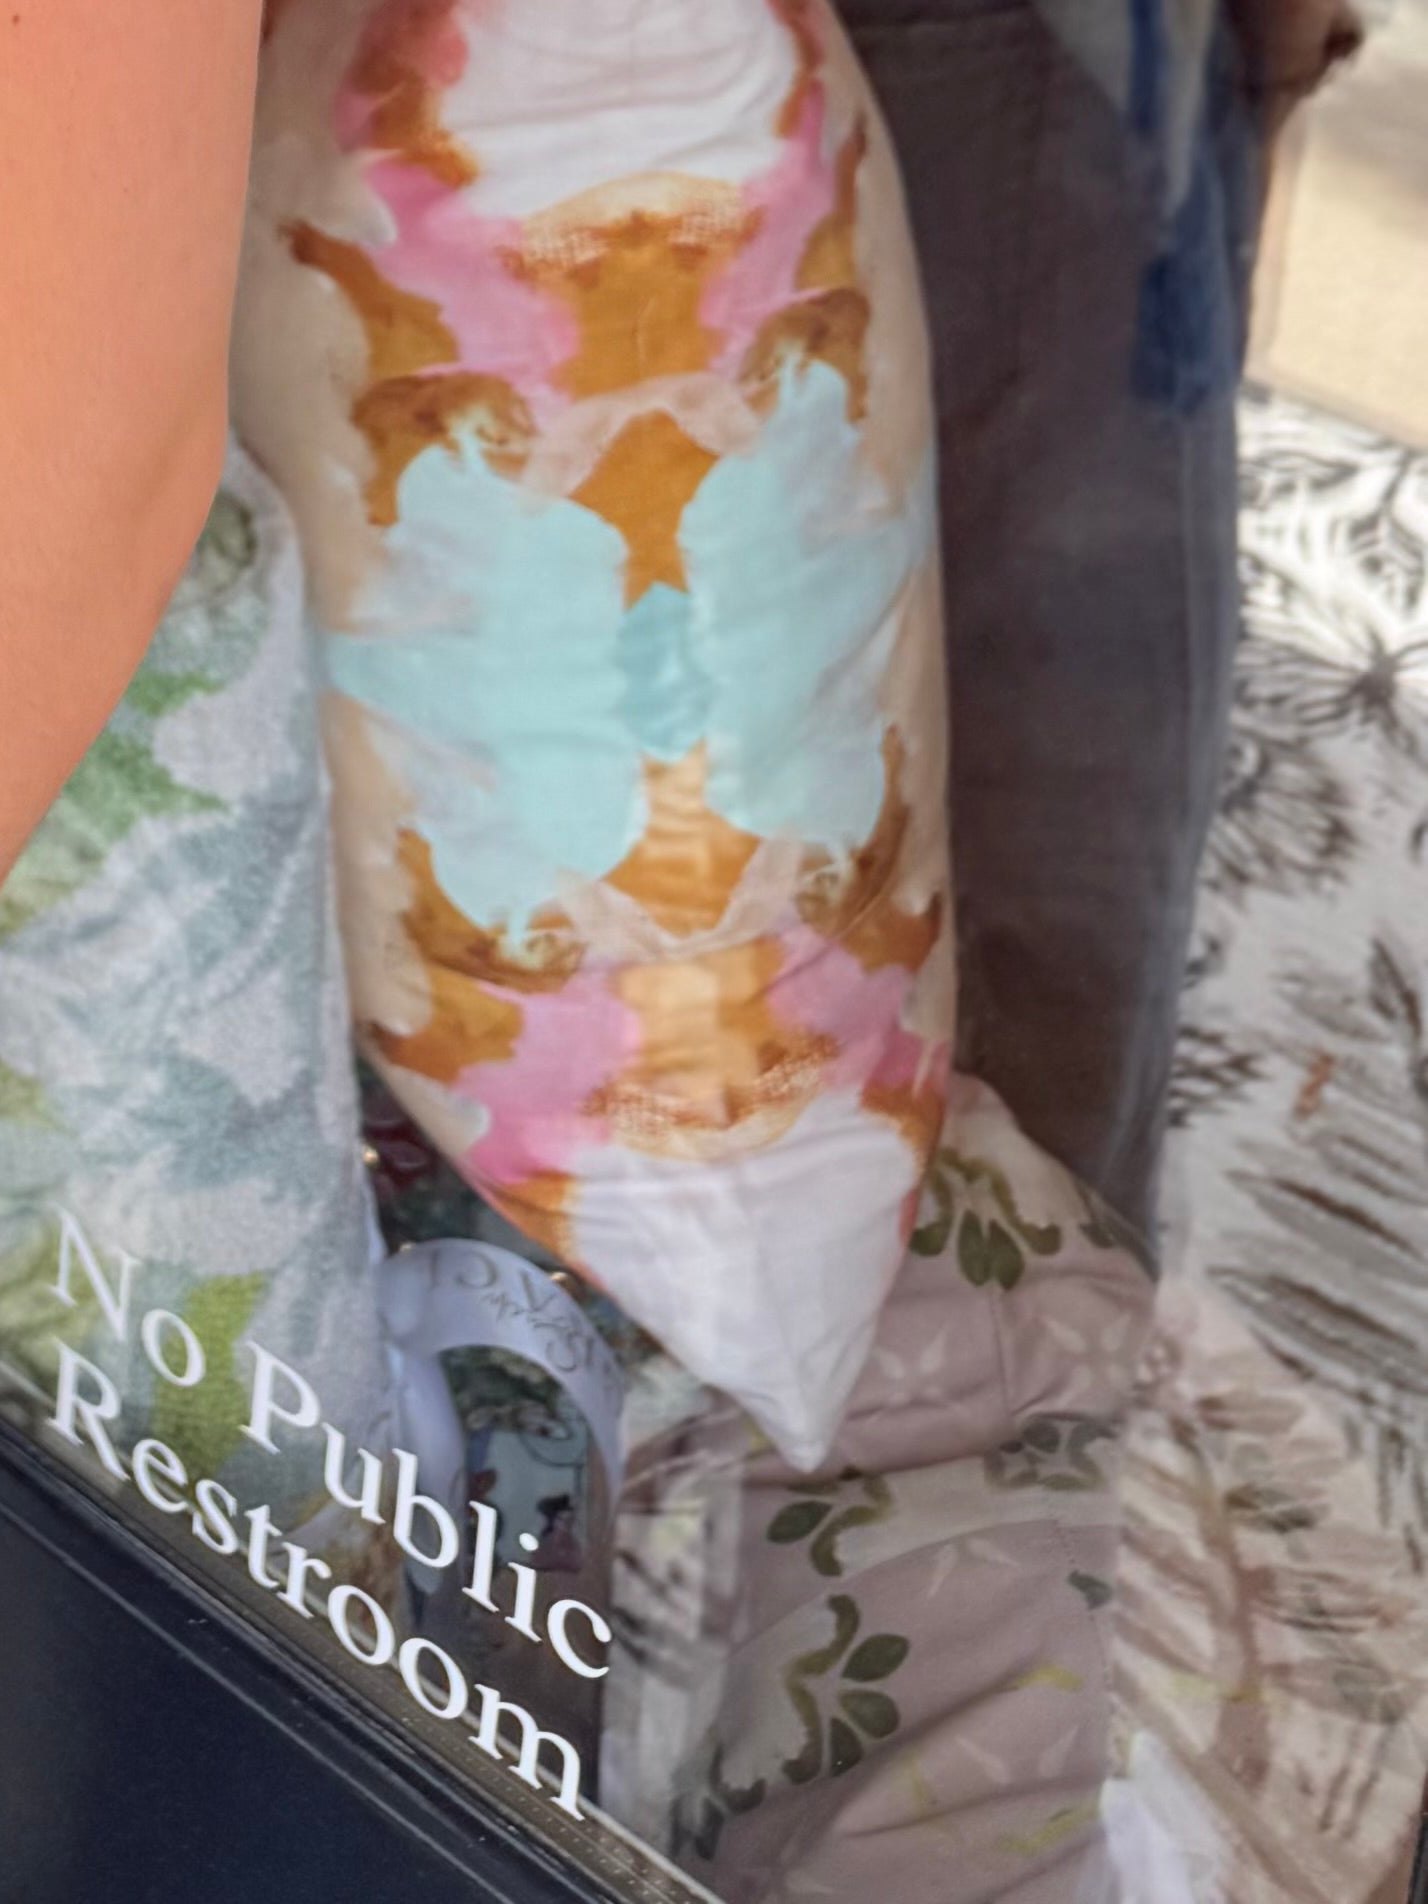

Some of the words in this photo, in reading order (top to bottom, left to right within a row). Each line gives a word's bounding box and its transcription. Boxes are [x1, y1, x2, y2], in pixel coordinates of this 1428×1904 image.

[46, 1202, 207, 1388] No
[238, 1339, 614, 1680] Public
[46, 1337, 588, 1822] Restroom
